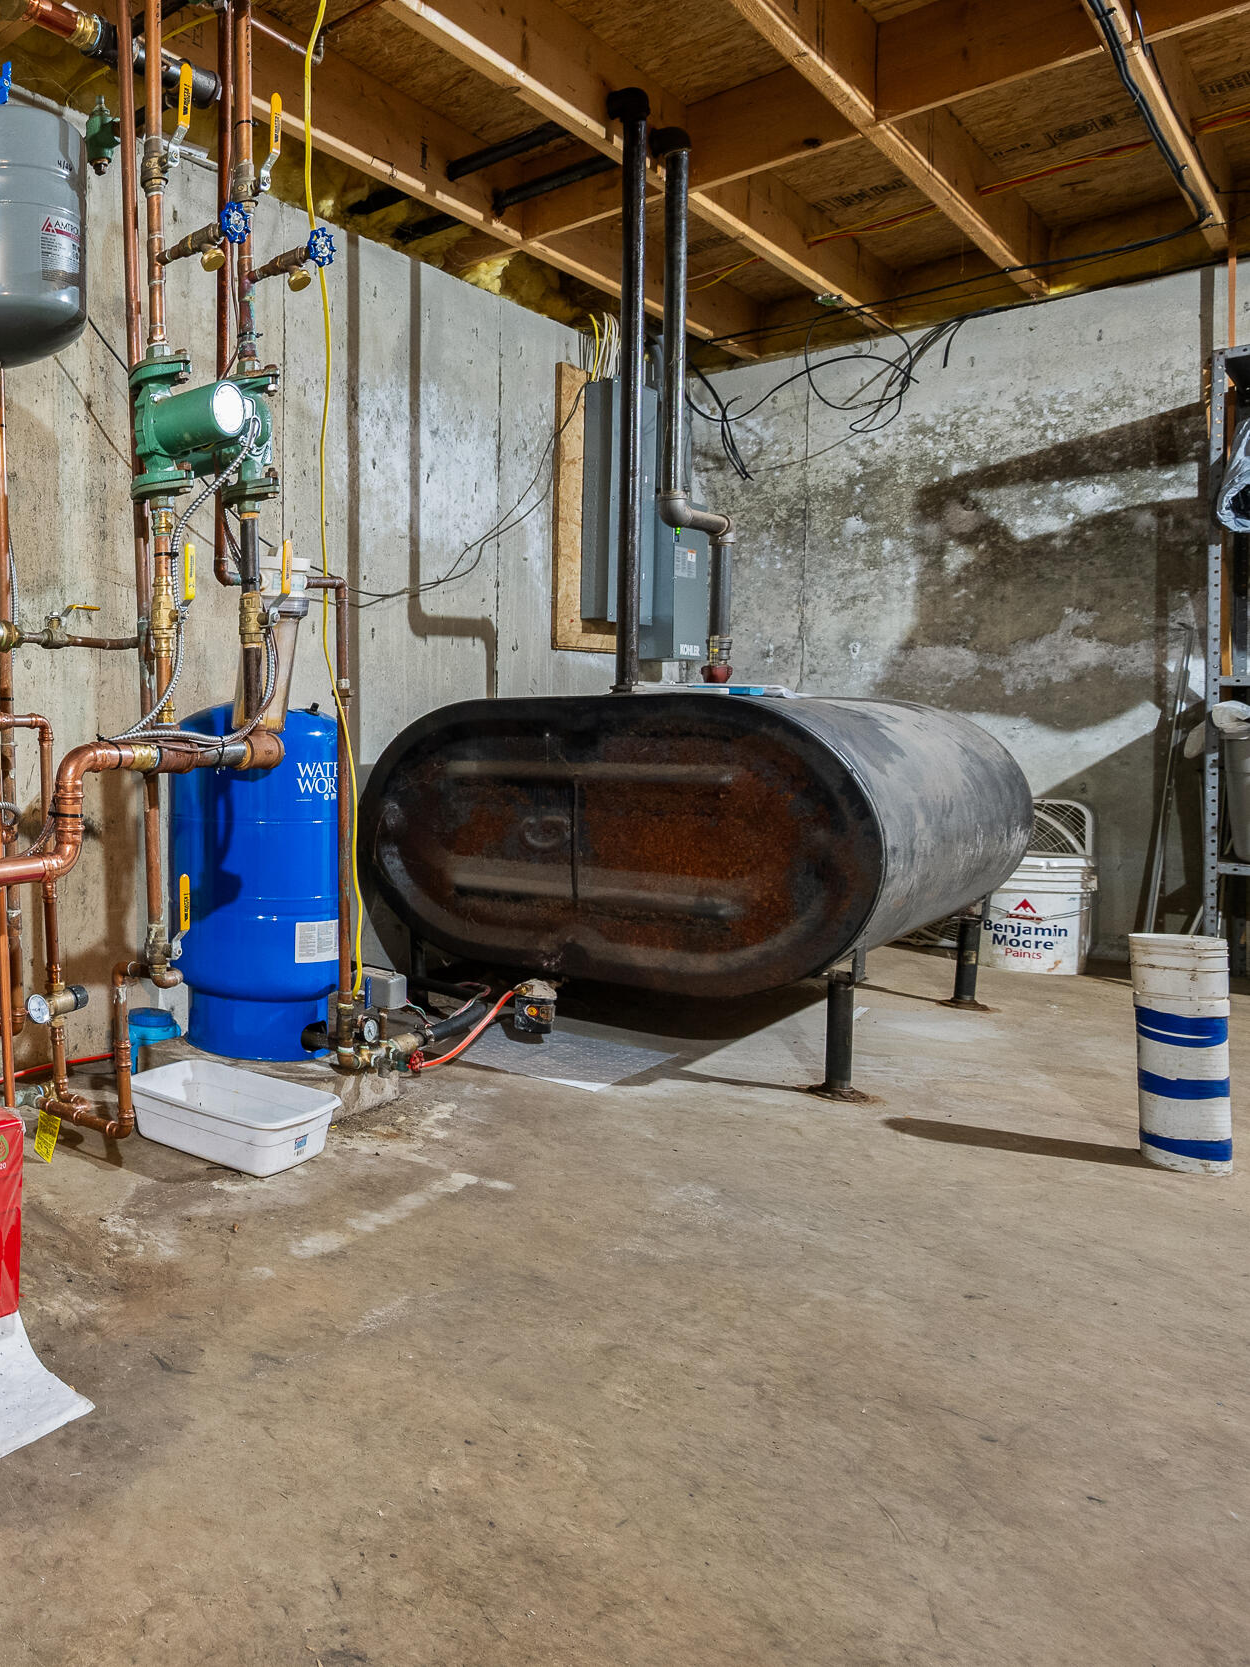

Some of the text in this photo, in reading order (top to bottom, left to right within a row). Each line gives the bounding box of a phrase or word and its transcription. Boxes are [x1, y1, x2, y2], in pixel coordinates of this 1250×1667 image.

[54, 220, 79, 236] AMTRO
[679, 643, 701, 657] KOHLER
[296, 761, 338, 778] WATE
[296, 777, 338, 794] WOR
[983, 919, 1068, 938] Benjamin
[992, 933, 1054, 950] Moore
[1004, 947, 1042, 960] Paints
